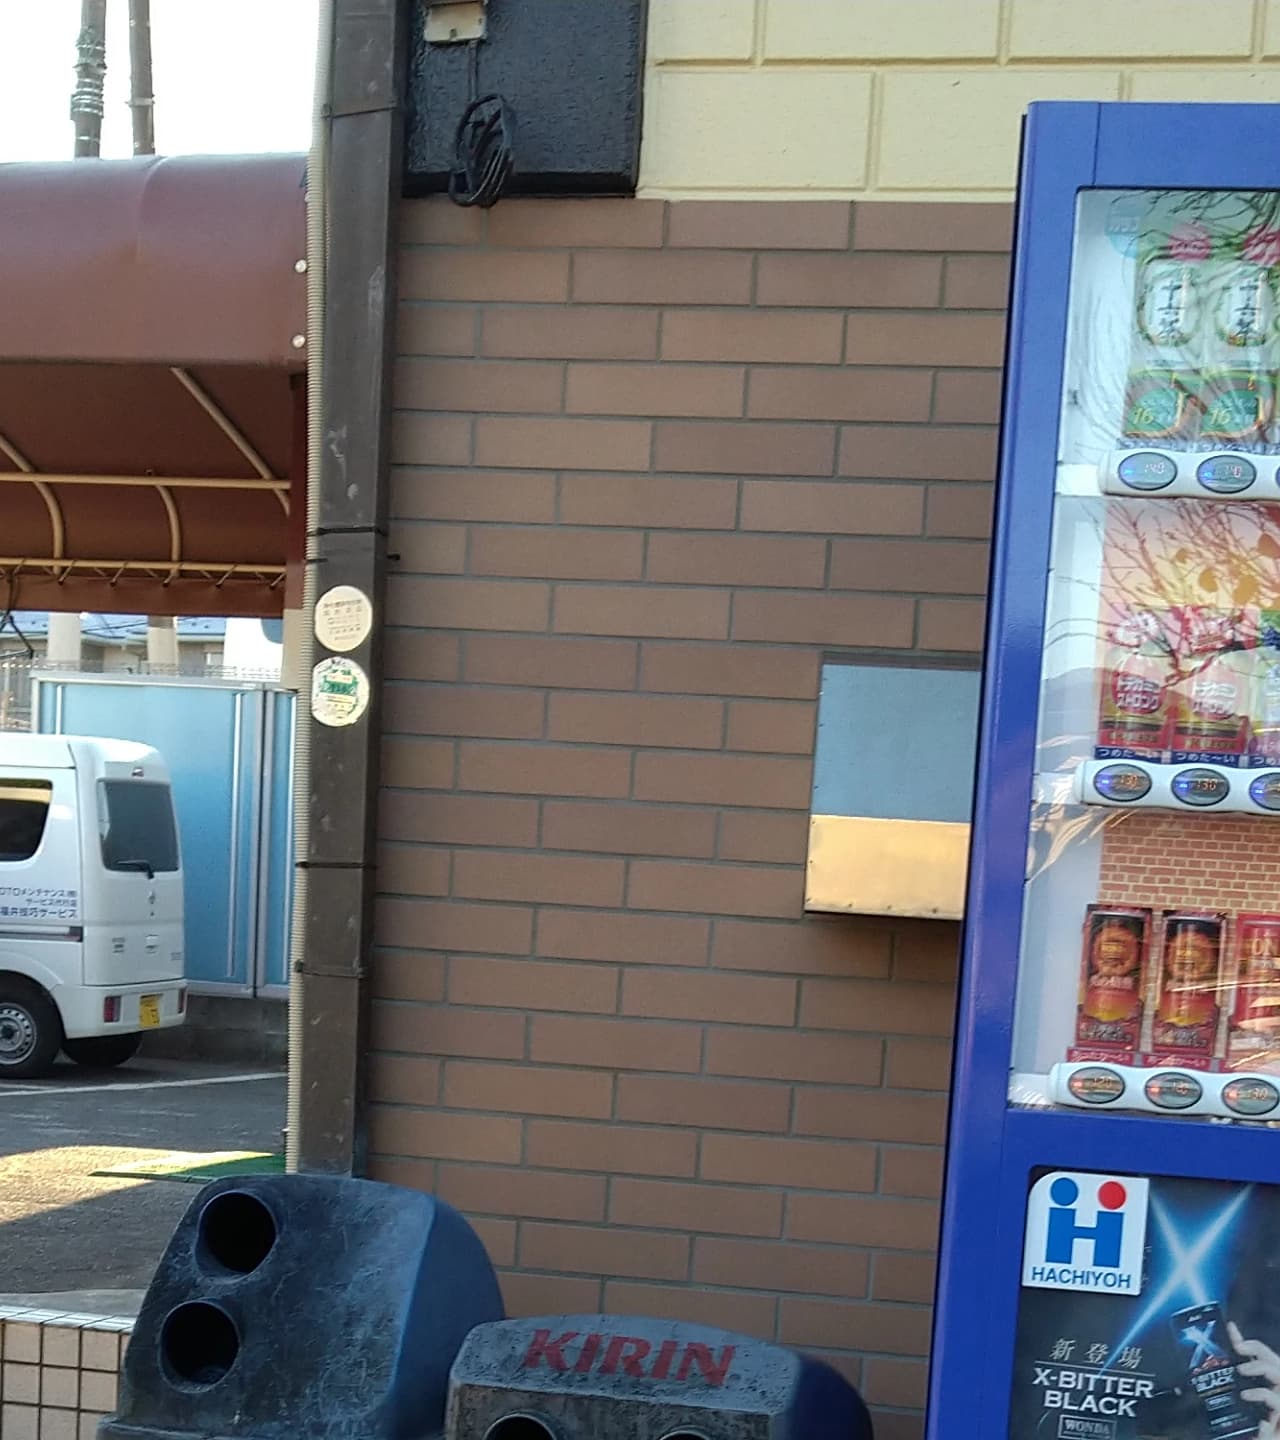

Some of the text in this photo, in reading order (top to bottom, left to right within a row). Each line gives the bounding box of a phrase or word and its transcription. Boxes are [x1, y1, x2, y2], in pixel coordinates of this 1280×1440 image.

[1030, 1266, 1132, 1289] HACHIYOH
[521, 1327, 737, 1387] KIRIN
[1032, 1367, 1154, 1400] X-BITTER
[1043, 1390, 1137, 1419] BLACK
